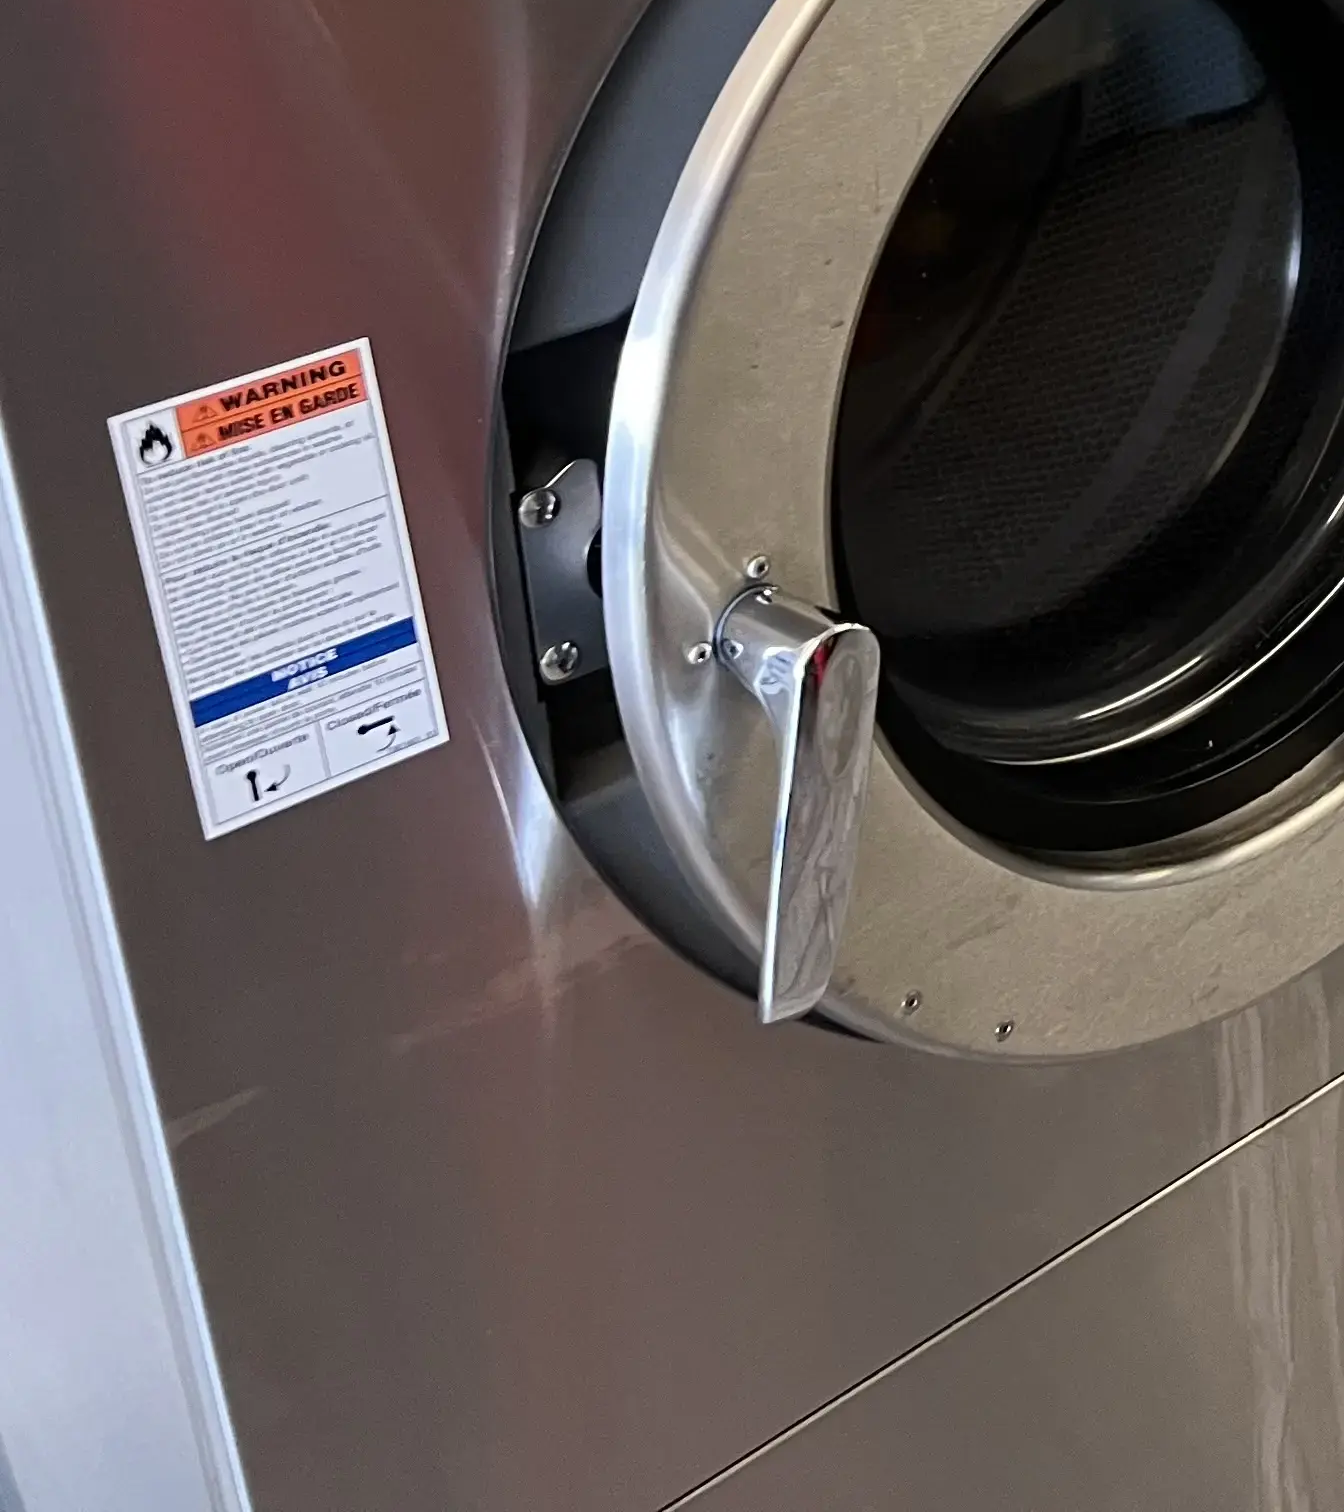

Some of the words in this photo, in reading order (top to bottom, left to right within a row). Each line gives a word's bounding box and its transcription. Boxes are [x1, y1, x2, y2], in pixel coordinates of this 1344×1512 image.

[216, 411, 266, 442] MISE
[269, 402, 295, 425] EN
[297, 380, 360, 415] GARDE
[219, 357, 346, 413] WARNING
[269, 646, 339, 683] NOTICE
